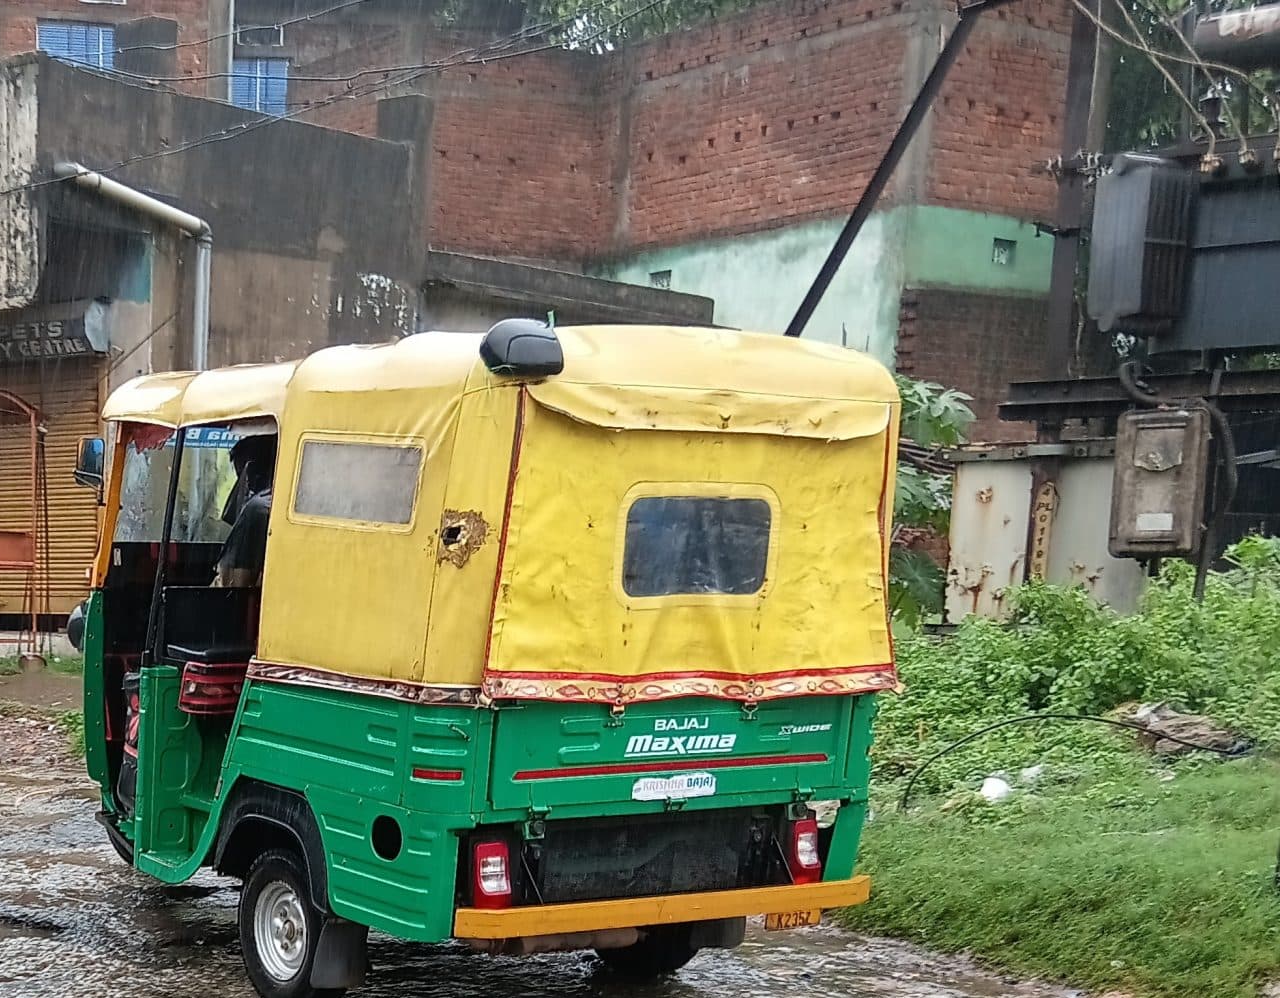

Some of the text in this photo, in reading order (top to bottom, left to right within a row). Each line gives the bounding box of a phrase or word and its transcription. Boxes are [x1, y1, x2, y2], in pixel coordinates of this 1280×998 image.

[19, 338, 87, 358] CENTRE
[654, 716, 709, 732] BAJAJ
[626, 733, 737, 756] Maxima
[687, 775, 714, 789] BAJAJ
